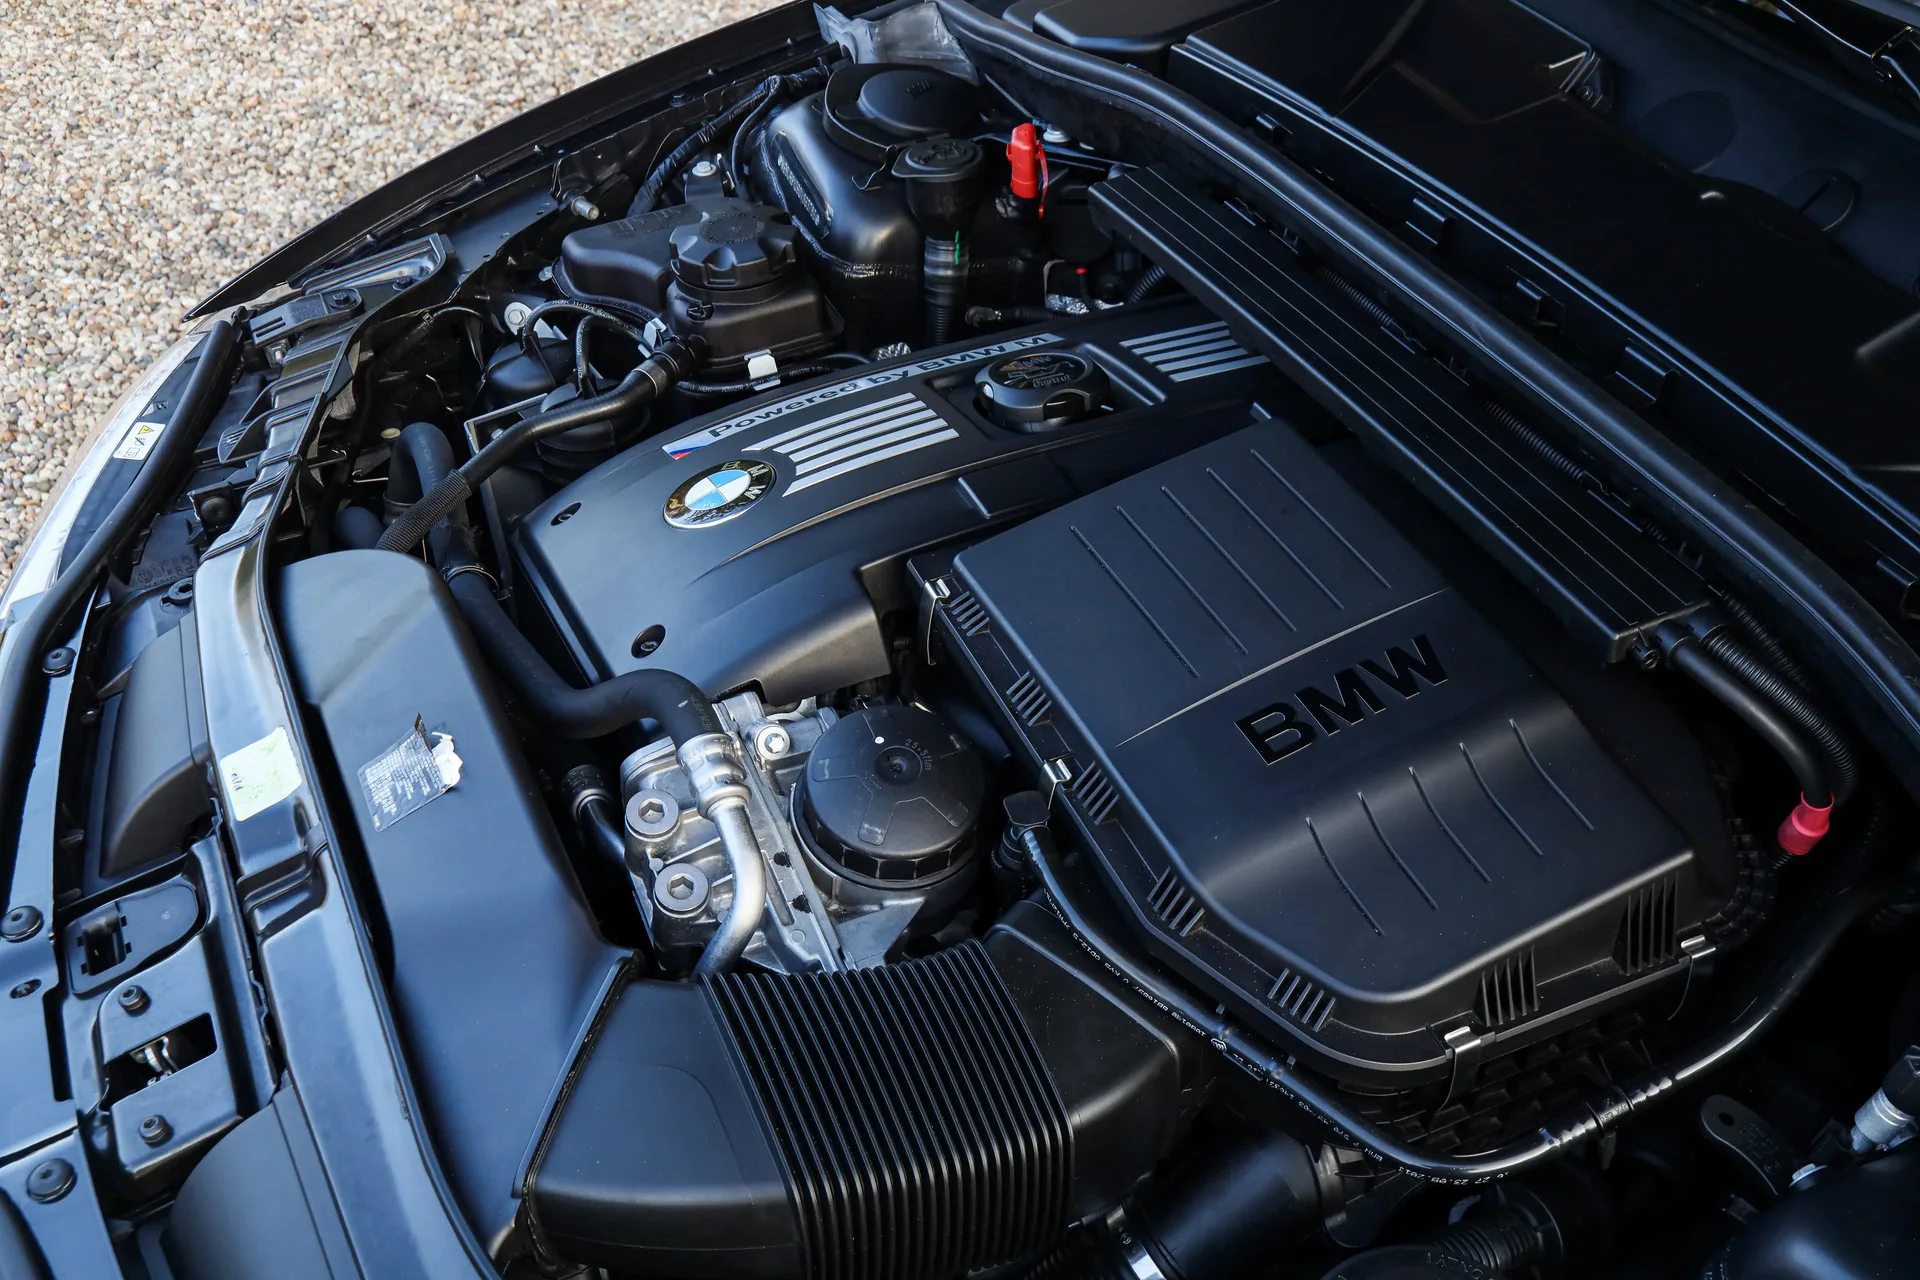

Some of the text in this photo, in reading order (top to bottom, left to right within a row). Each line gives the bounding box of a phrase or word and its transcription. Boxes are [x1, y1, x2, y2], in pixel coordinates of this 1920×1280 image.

[708, 381, 859, 438] Powered
[867, 369, 910, 385] by
[915, 344, 1007, 371] BMW
[1016, 335, 1049, 349] M
[1235, 634, 1448, 766] BMW
